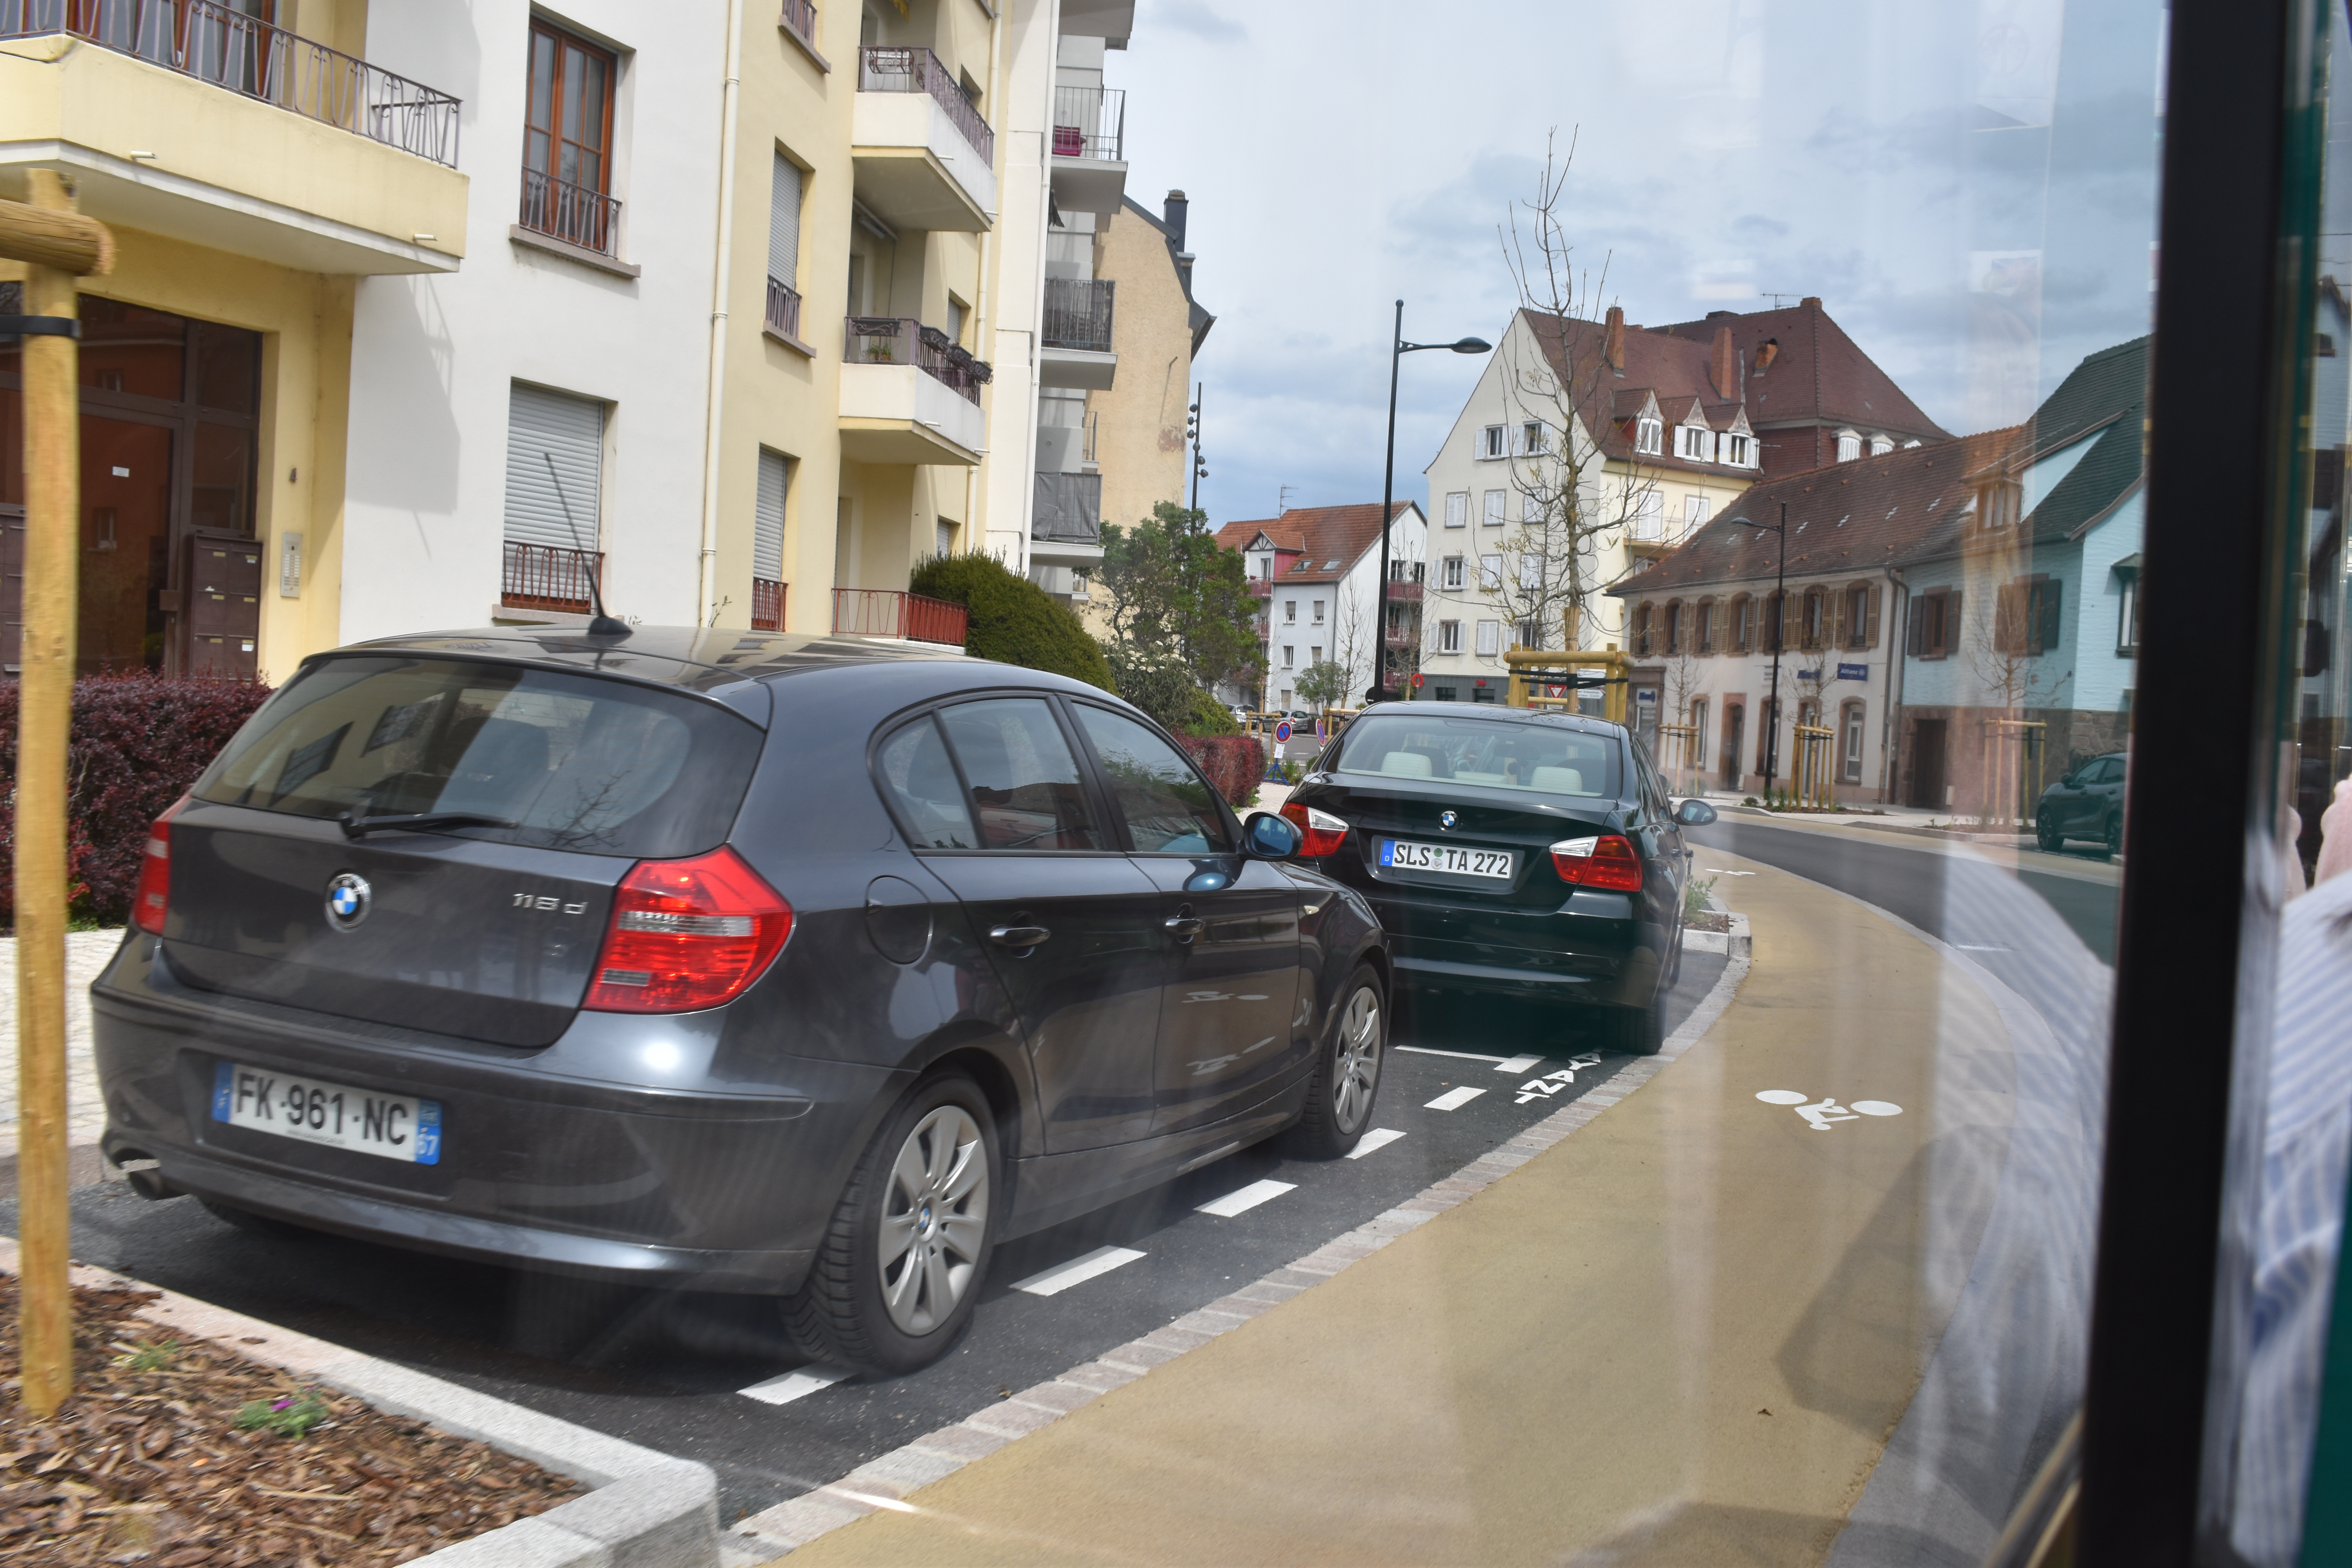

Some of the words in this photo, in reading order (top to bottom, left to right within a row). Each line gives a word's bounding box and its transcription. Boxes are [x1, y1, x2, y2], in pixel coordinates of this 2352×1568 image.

[1394, 844, 1431, 867] SLS
[1446, 849, 1468, 871] TA
[1473, 853, 1509, 875] 272
[416, 1133, 439, 1156] 67
